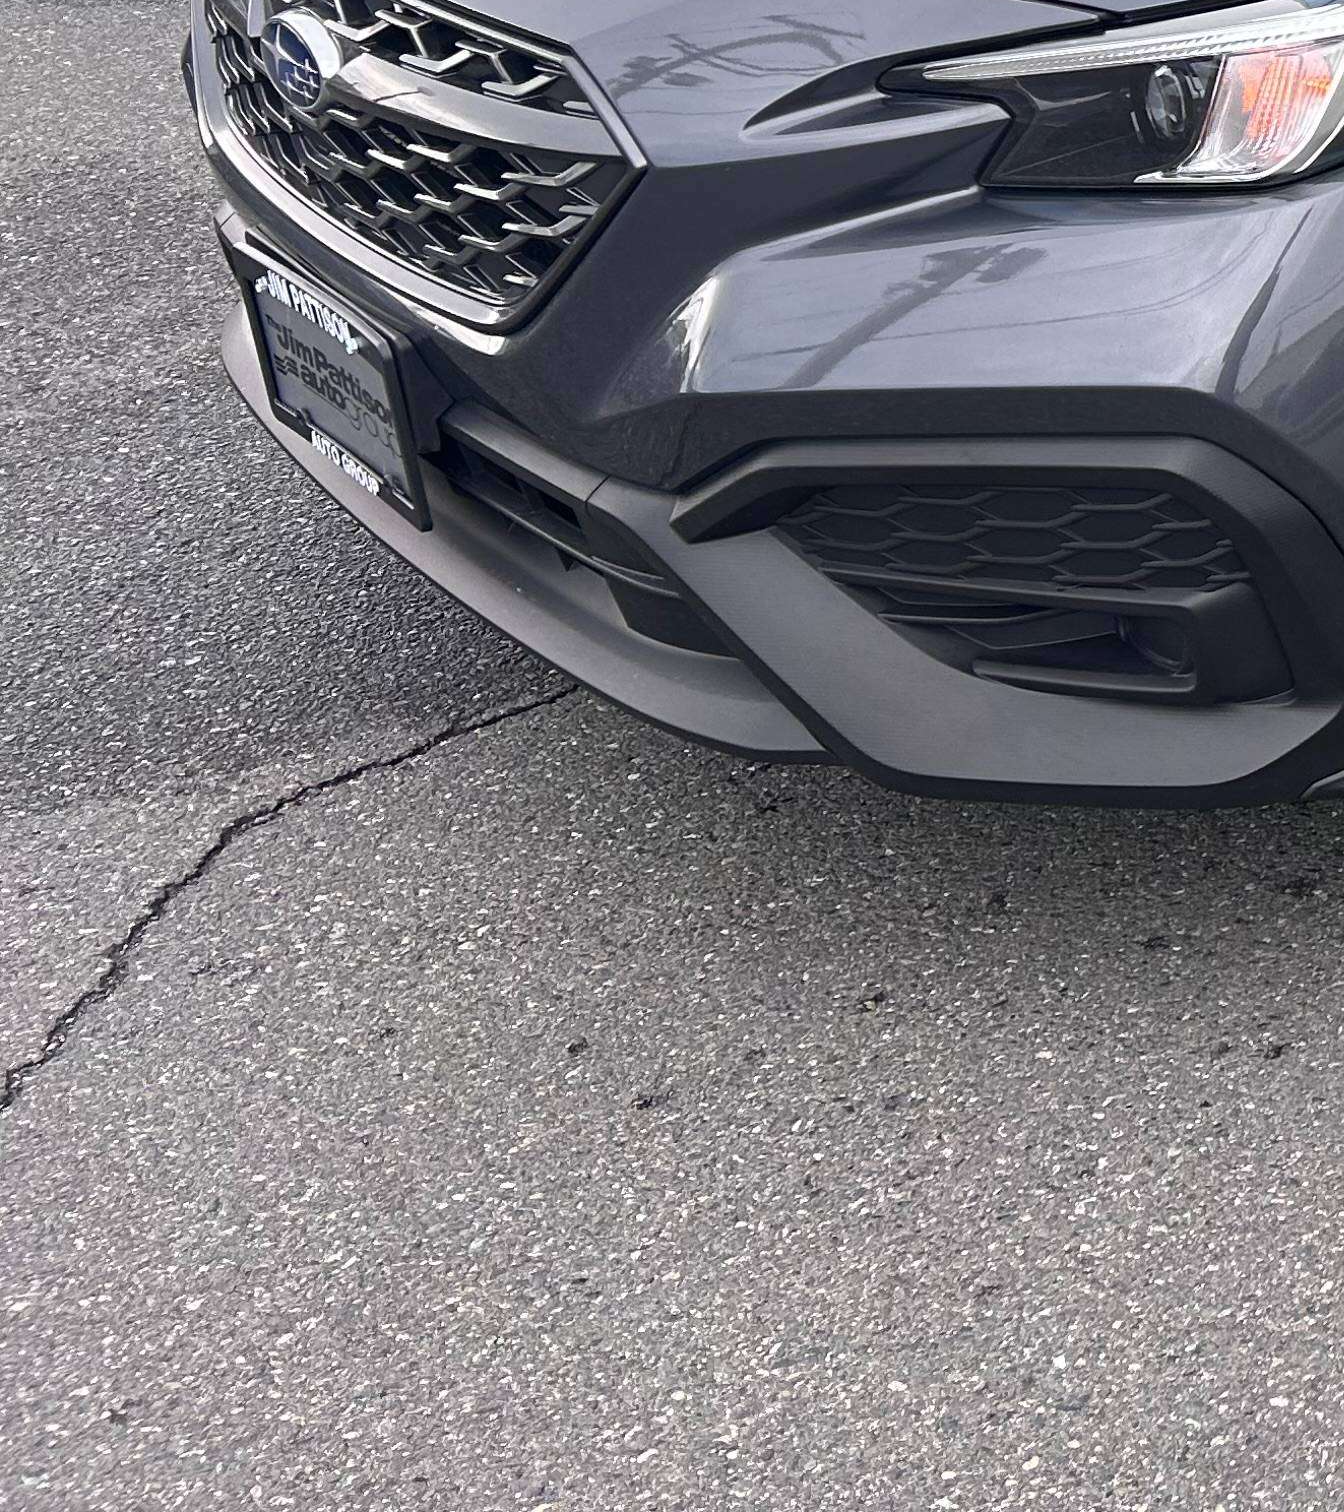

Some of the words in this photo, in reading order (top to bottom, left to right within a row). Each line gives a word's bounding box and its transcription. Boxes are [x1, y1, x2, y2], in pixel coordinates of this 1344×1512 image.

[267, 270, 292, 308] JIM
[289, 283, 350, 346] PATTISON
[277, 326, 313, 370] Jim
[311, 430, 341, 466] AUTO
[341, 453, 381, 496] GROUP
